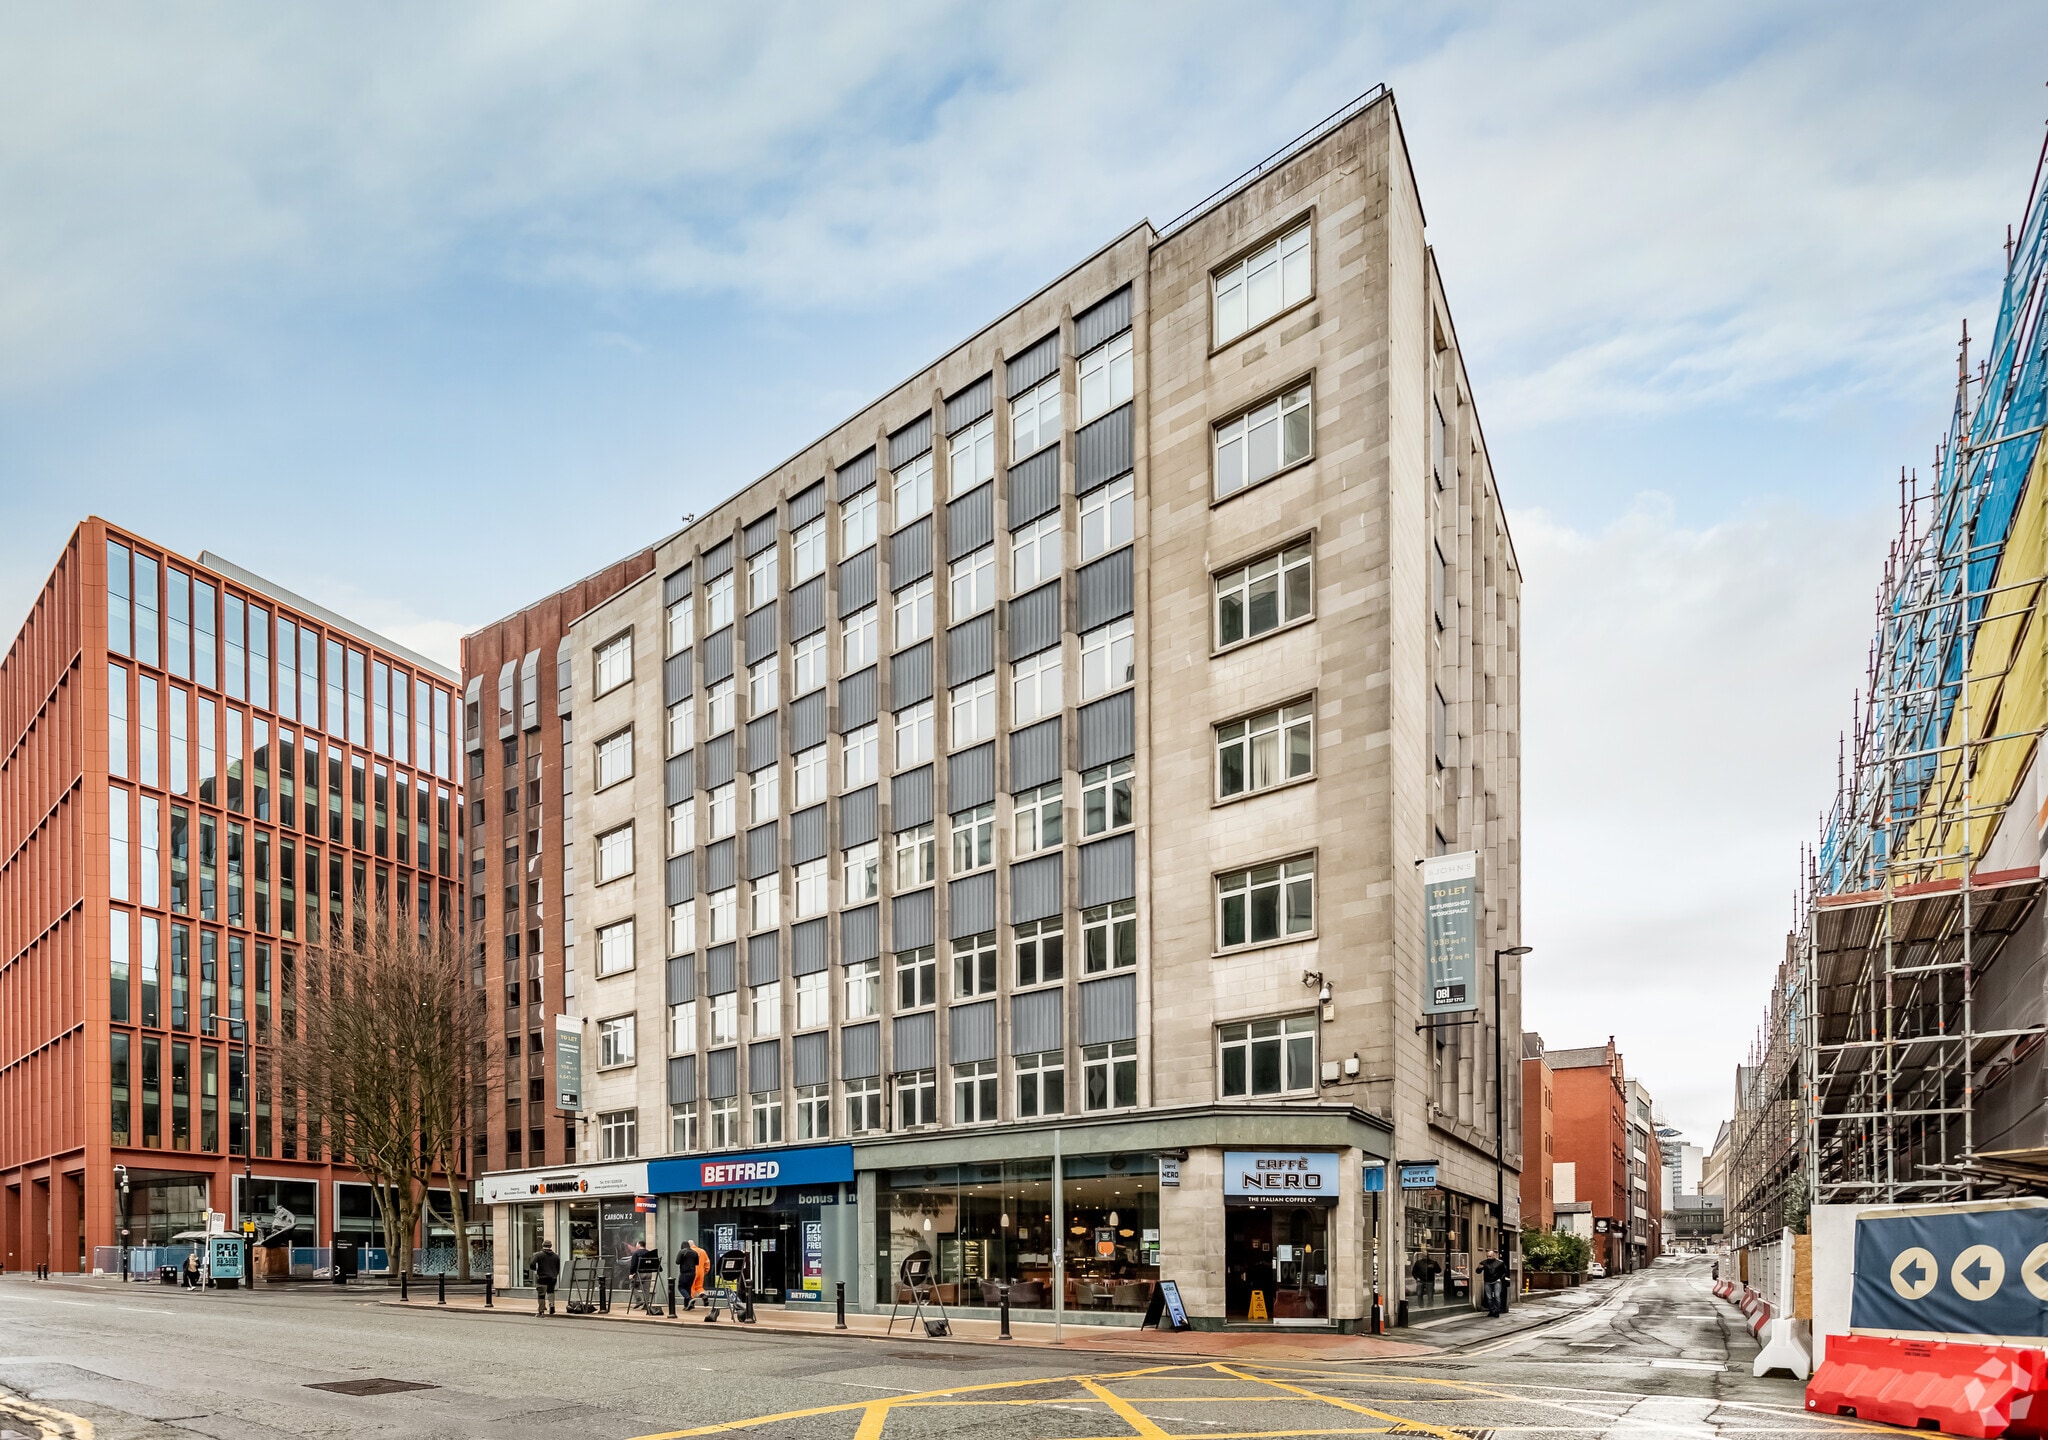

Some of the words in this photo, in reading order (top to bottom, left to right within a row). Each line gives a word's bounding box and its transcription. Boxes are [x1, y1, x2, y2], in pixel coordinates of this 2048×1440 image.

[1433, 889, 1446, 898] TO
[1448, 886, 1467, 896] LET
[1429, 900, 1470, 910] REFURBISHED
[1431, 907, 1468, 917] WORKSPACE
[704, 1161, 779, 1183] BETFRED
[1242, 1171, 1322, 1189] NERO
[530, 1184, 539, 1194] UP
[546, 1181, 579, 1193] RUNNING
[798, 1193, 833, 1205] bonus
[629, 1212, 633, 1220] 2
